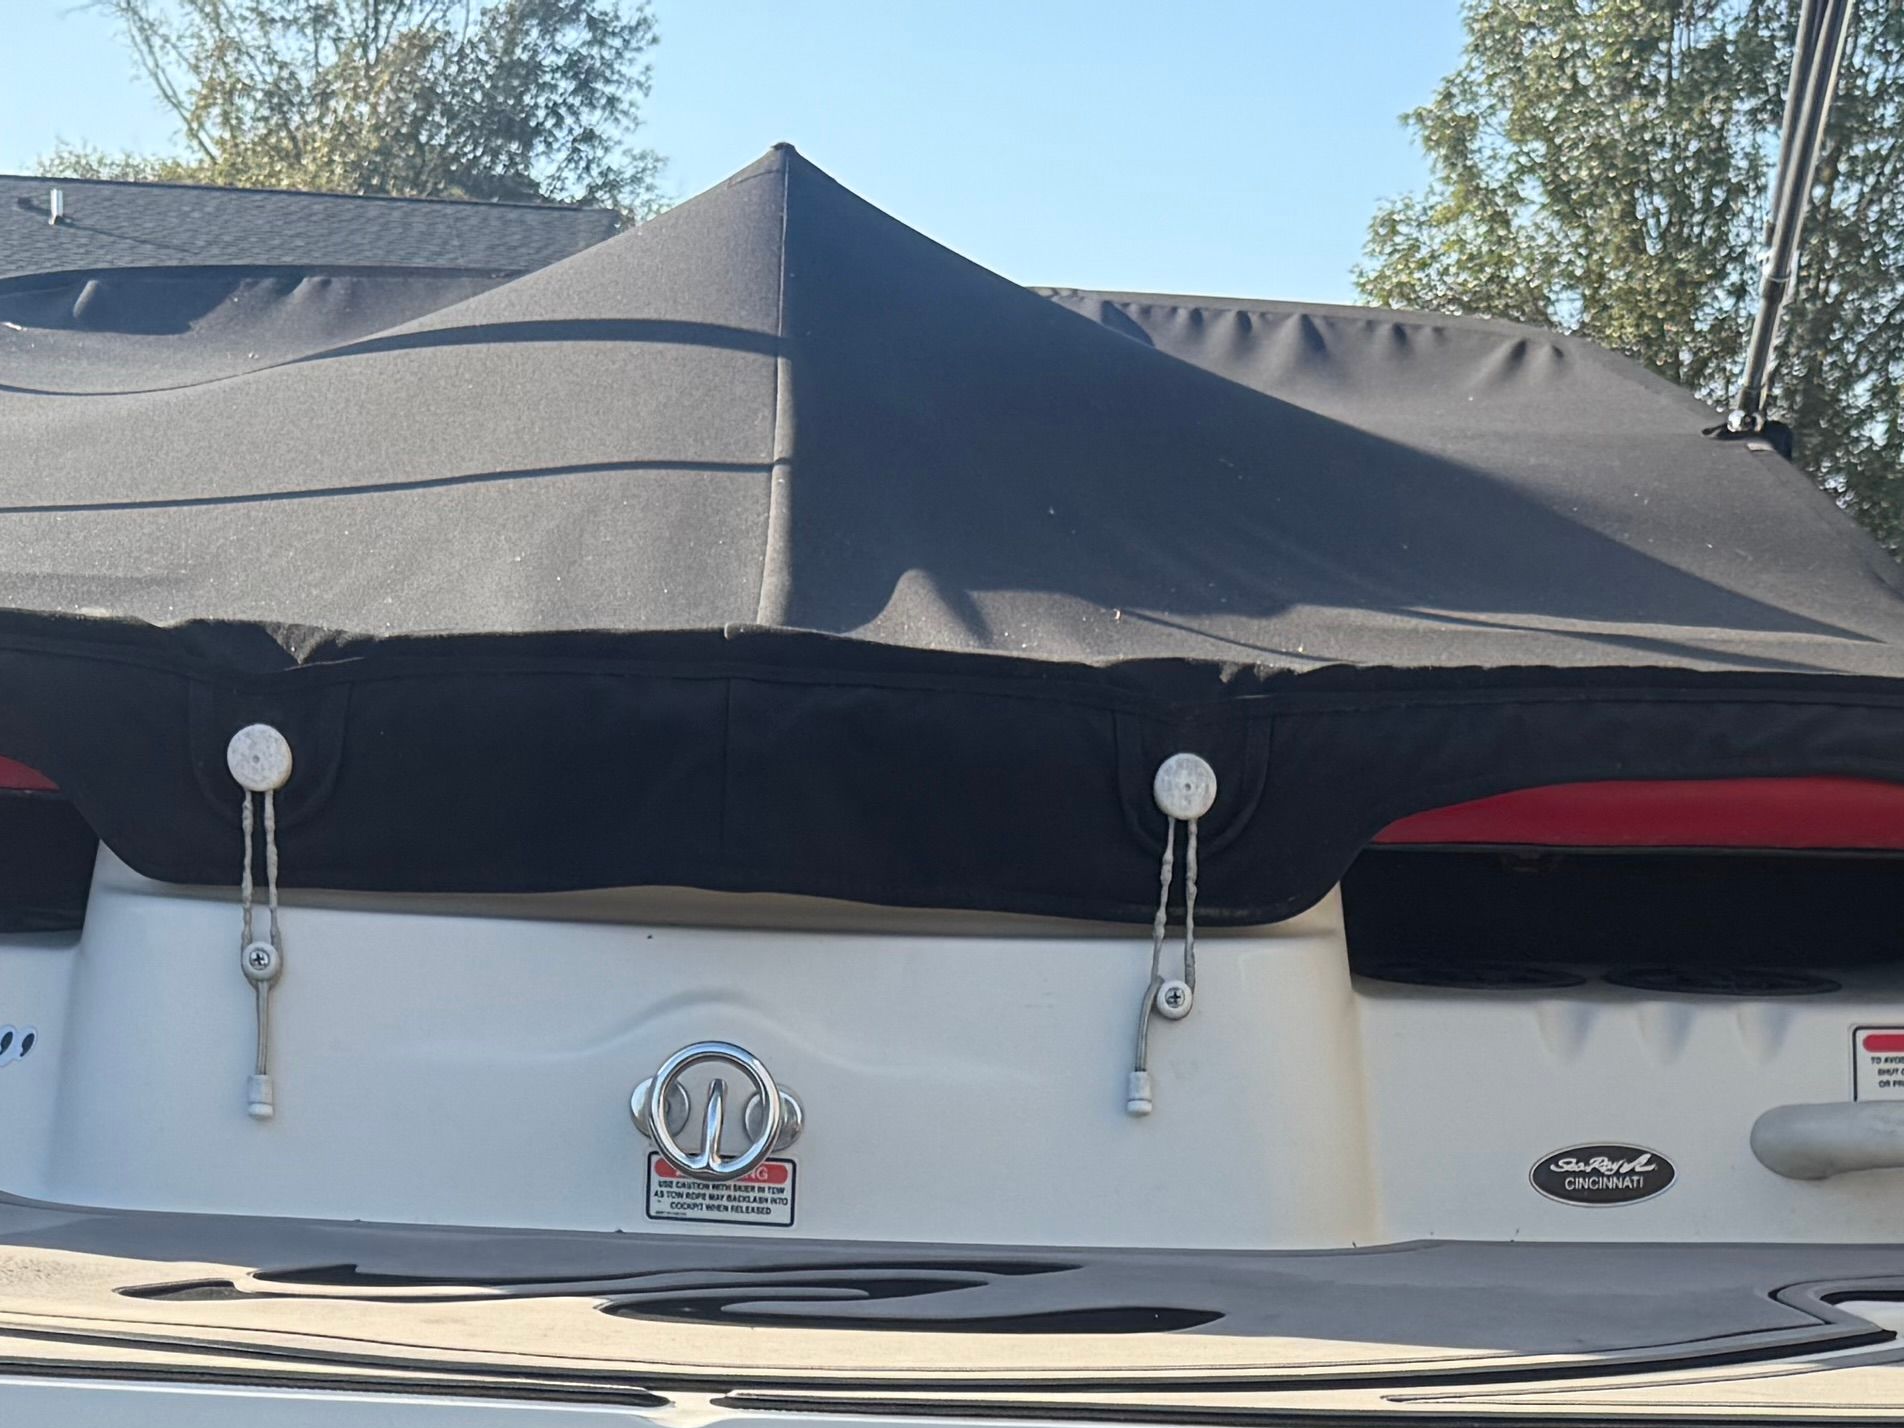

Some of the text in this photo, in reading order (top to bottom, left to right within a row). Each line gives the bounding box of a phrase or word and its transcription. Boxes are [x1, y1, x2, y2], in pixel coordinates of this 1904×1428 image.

[1878, 1080, 1890, 1088] OR
[675, 1181, 710, 1190] CAUTION
[1565, 1176, 1644, 1190] CINCINNATI
[666, 1190, 684, 1200] TOW
[708, 1192, 725, 1201] MAY
[726, 1194, 769, 1204] BACKLASH
[770, 1196, 788, 1206] INTO
[705, 1202, 729, 1212] WHEN
[730, 1204, 772, 1215] RELEASED
